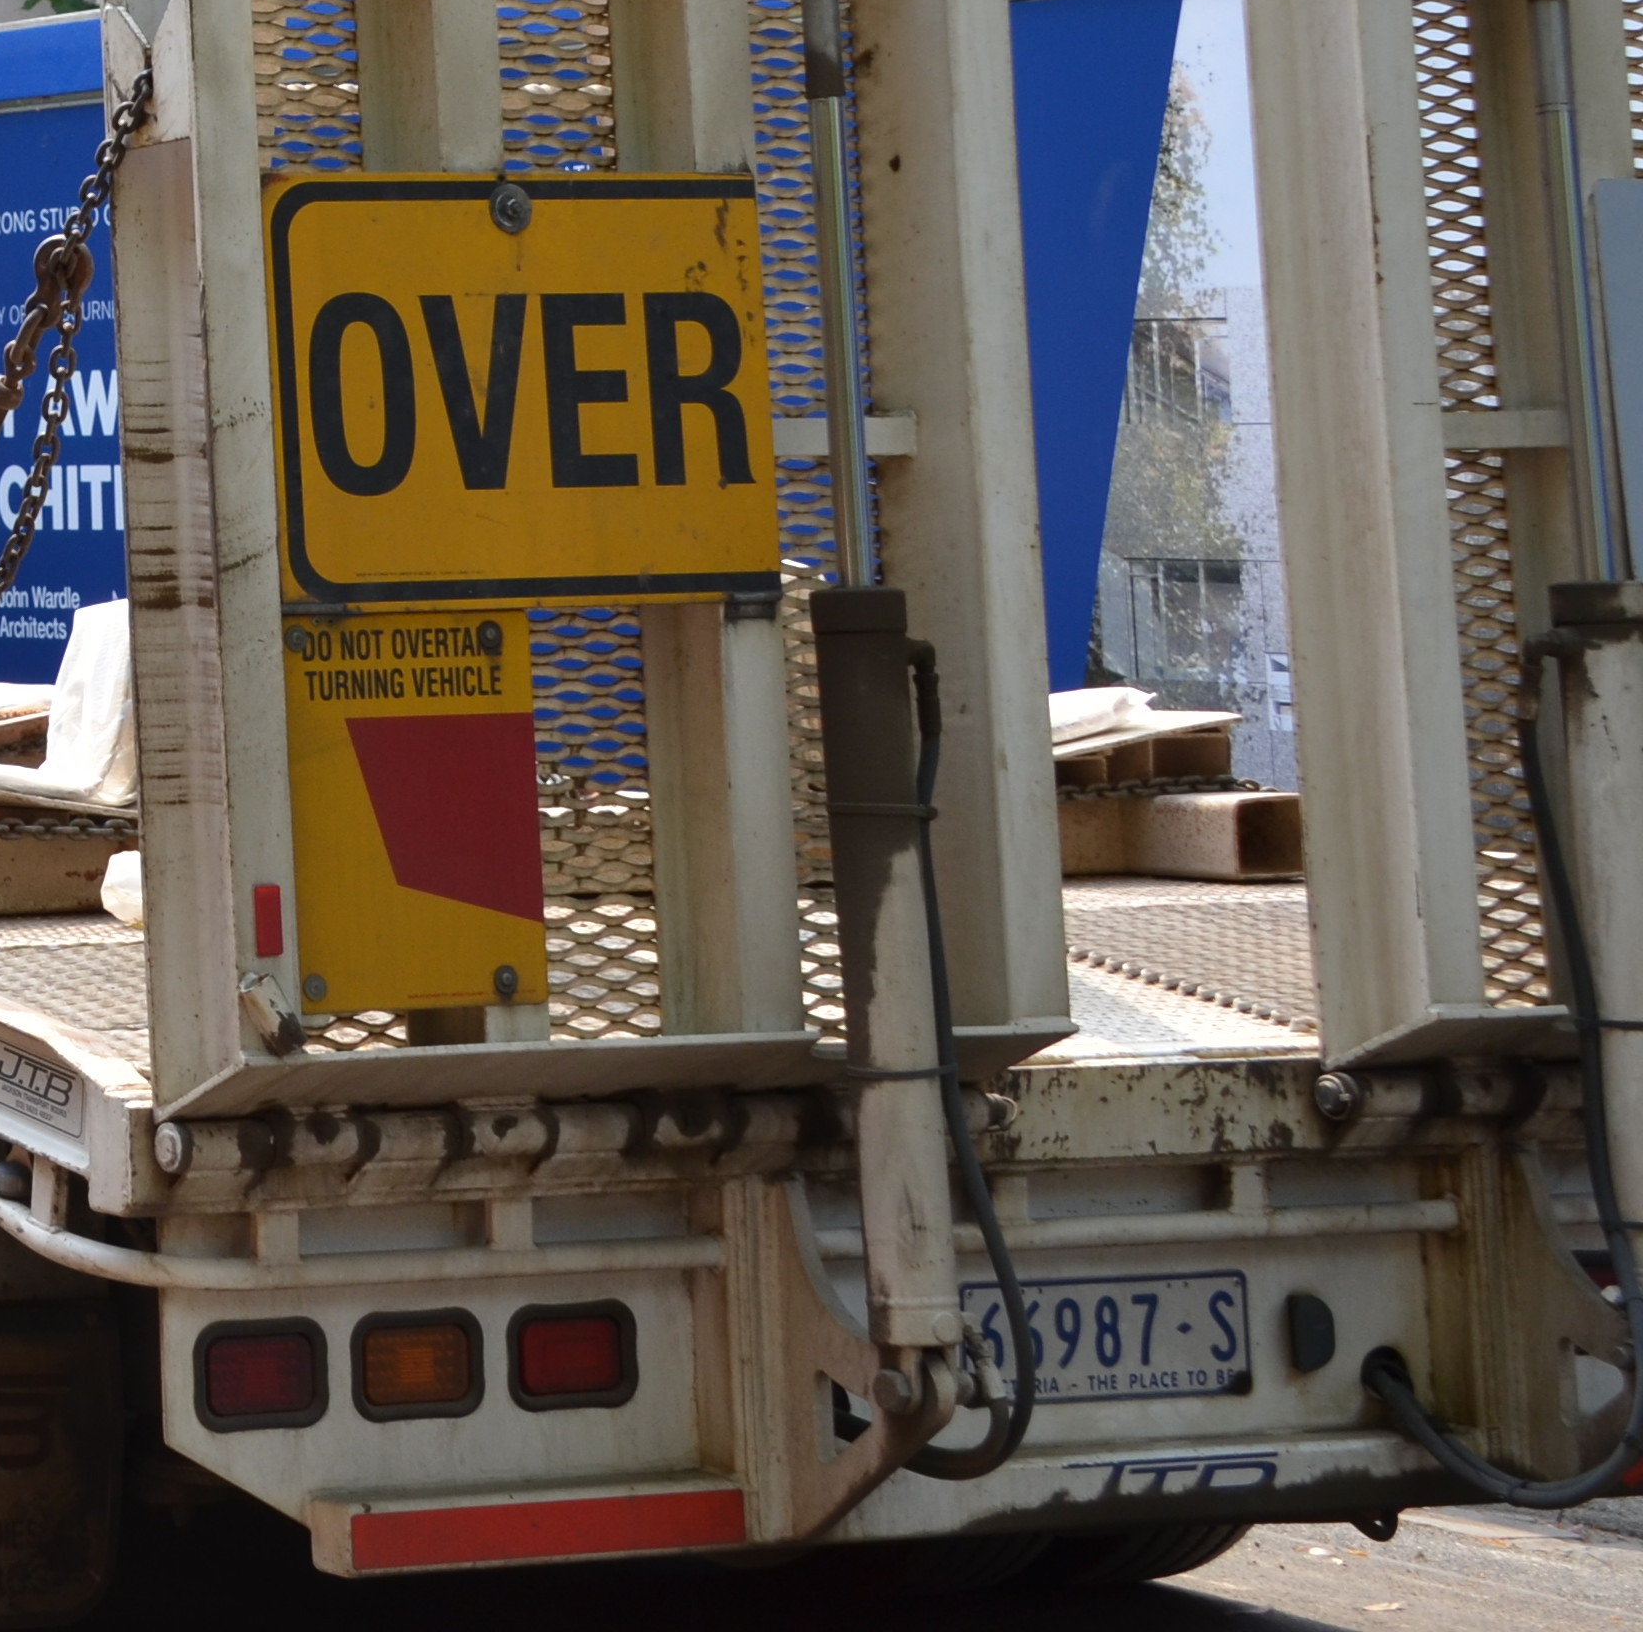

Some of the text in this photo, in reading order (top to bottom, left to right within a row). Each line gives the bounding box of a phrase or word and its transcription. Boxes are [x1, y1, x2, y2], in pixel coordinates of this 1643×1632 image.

[39, 205, 100, 231] STUDO
[308, 291, 757, 498] OVER
[31, 585, 80, 609] Wardle
[0, 618, 67, 640] Architects
[302, 626, 503, 663] DO NOT OVERTA
[304, 666, 503, 702] TURNING VEHICLE
[1087, 1373, 1117, 1392] THE
[1129, 1371, 1179, 1389] PLACE
[1187, 1369, 1208, 1387] TO
